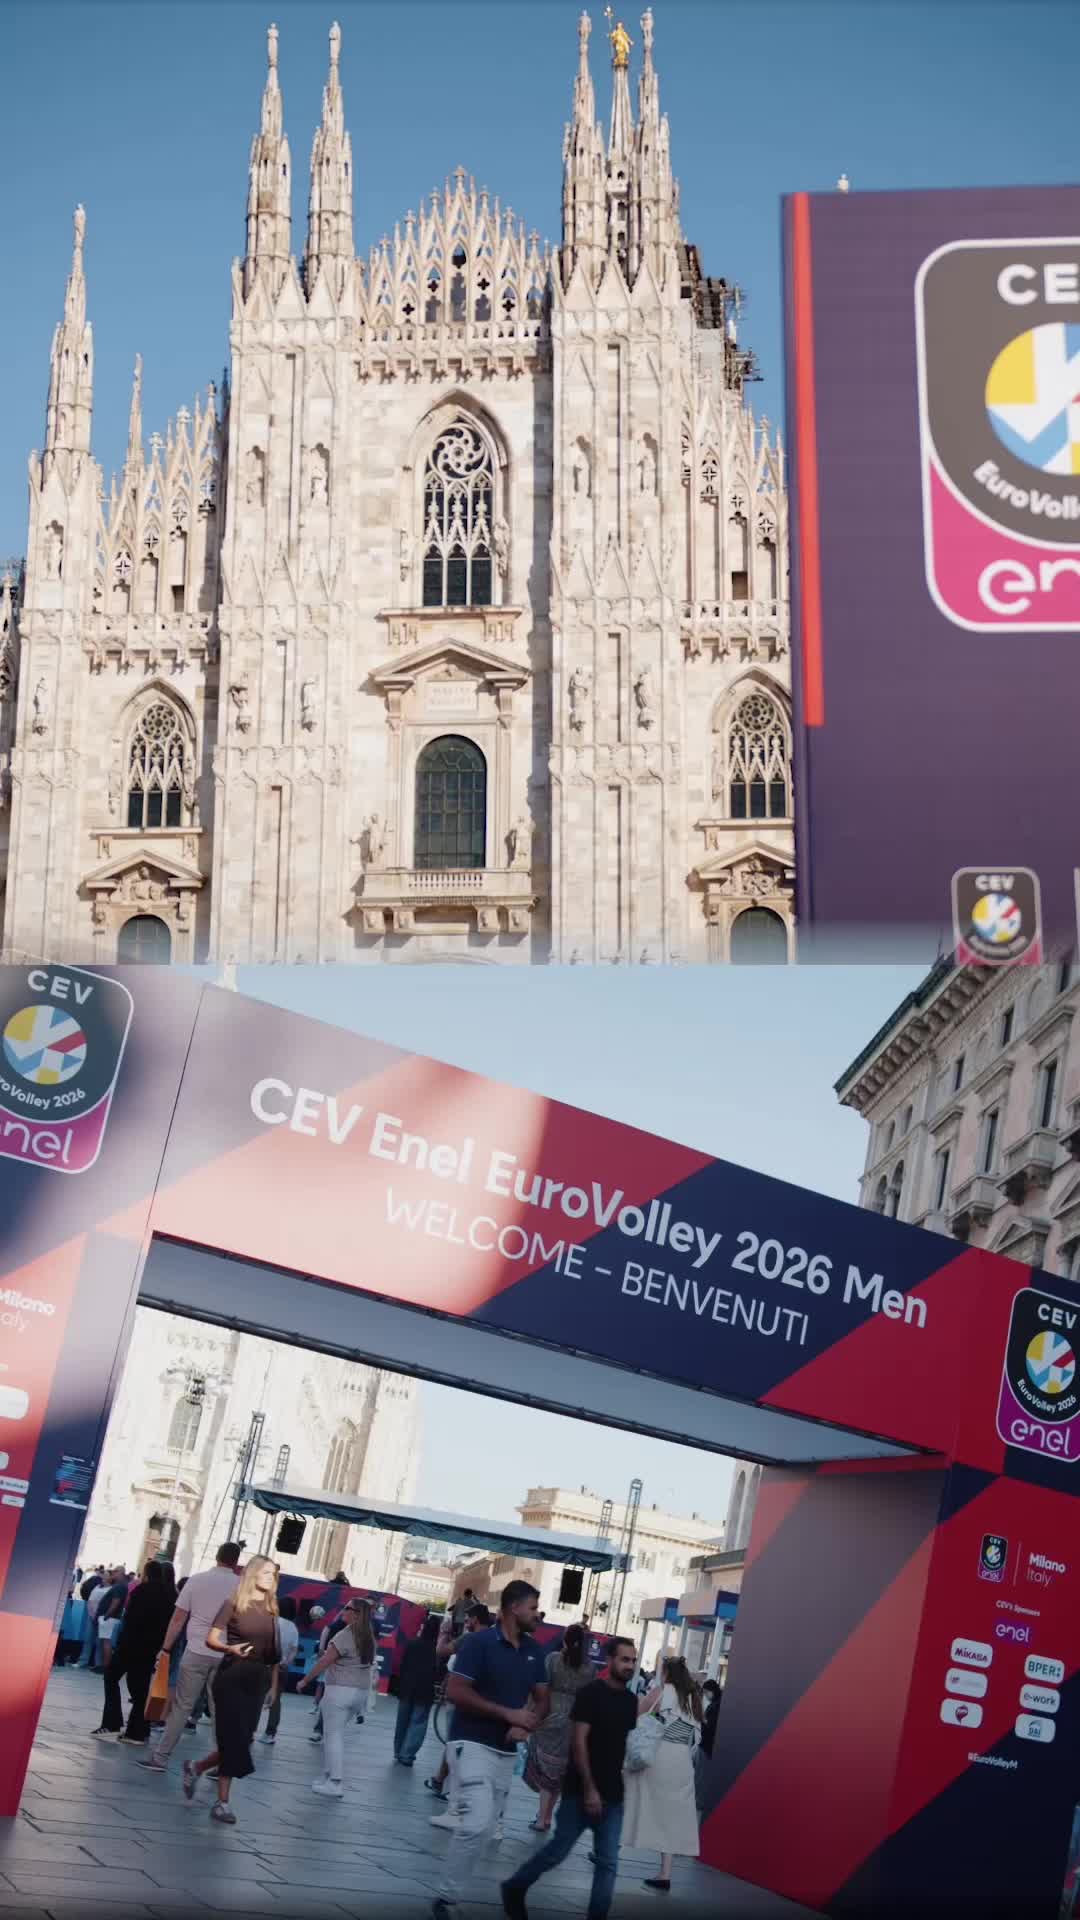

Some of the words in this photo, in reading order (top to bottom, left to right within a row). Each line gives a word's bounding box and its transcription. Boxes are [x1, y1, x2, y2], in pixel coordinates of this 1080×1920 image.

[973, 459, 1080, 519] EuroVoll
[27, 969, 94, 1005] CEV
[53, 1088, 86, 1108] 2026
[0, 1121, 73, 1164] nel
[250, 1078, 362, 1145] CEV
[368, 1112, 474, 1184] Enel
[485, 1151, 722, 1268] EuroVolley
[731, 1231, 833, 1295] 2026
[843, 1265, 927, 1328] Men
[385, 1186, 587, 1279] WELCOME
[621, 1261, 809, 1345] BENVENUTI
[1037, 1303, 1078, 1330] CEV
[1017, 1379, 1057, 1414] EuroVolley
[1057, 1394, 1077, 1411] 2026
[1010, 1419, 1071, 1456] enel
[1027, 1566, 1051, 1588] Italy
[1029, 1552, 1066, 1573] Milano
[995, 1623, 1030, 1643] enel
[1023, 1692, 1056, 1706] e-work
